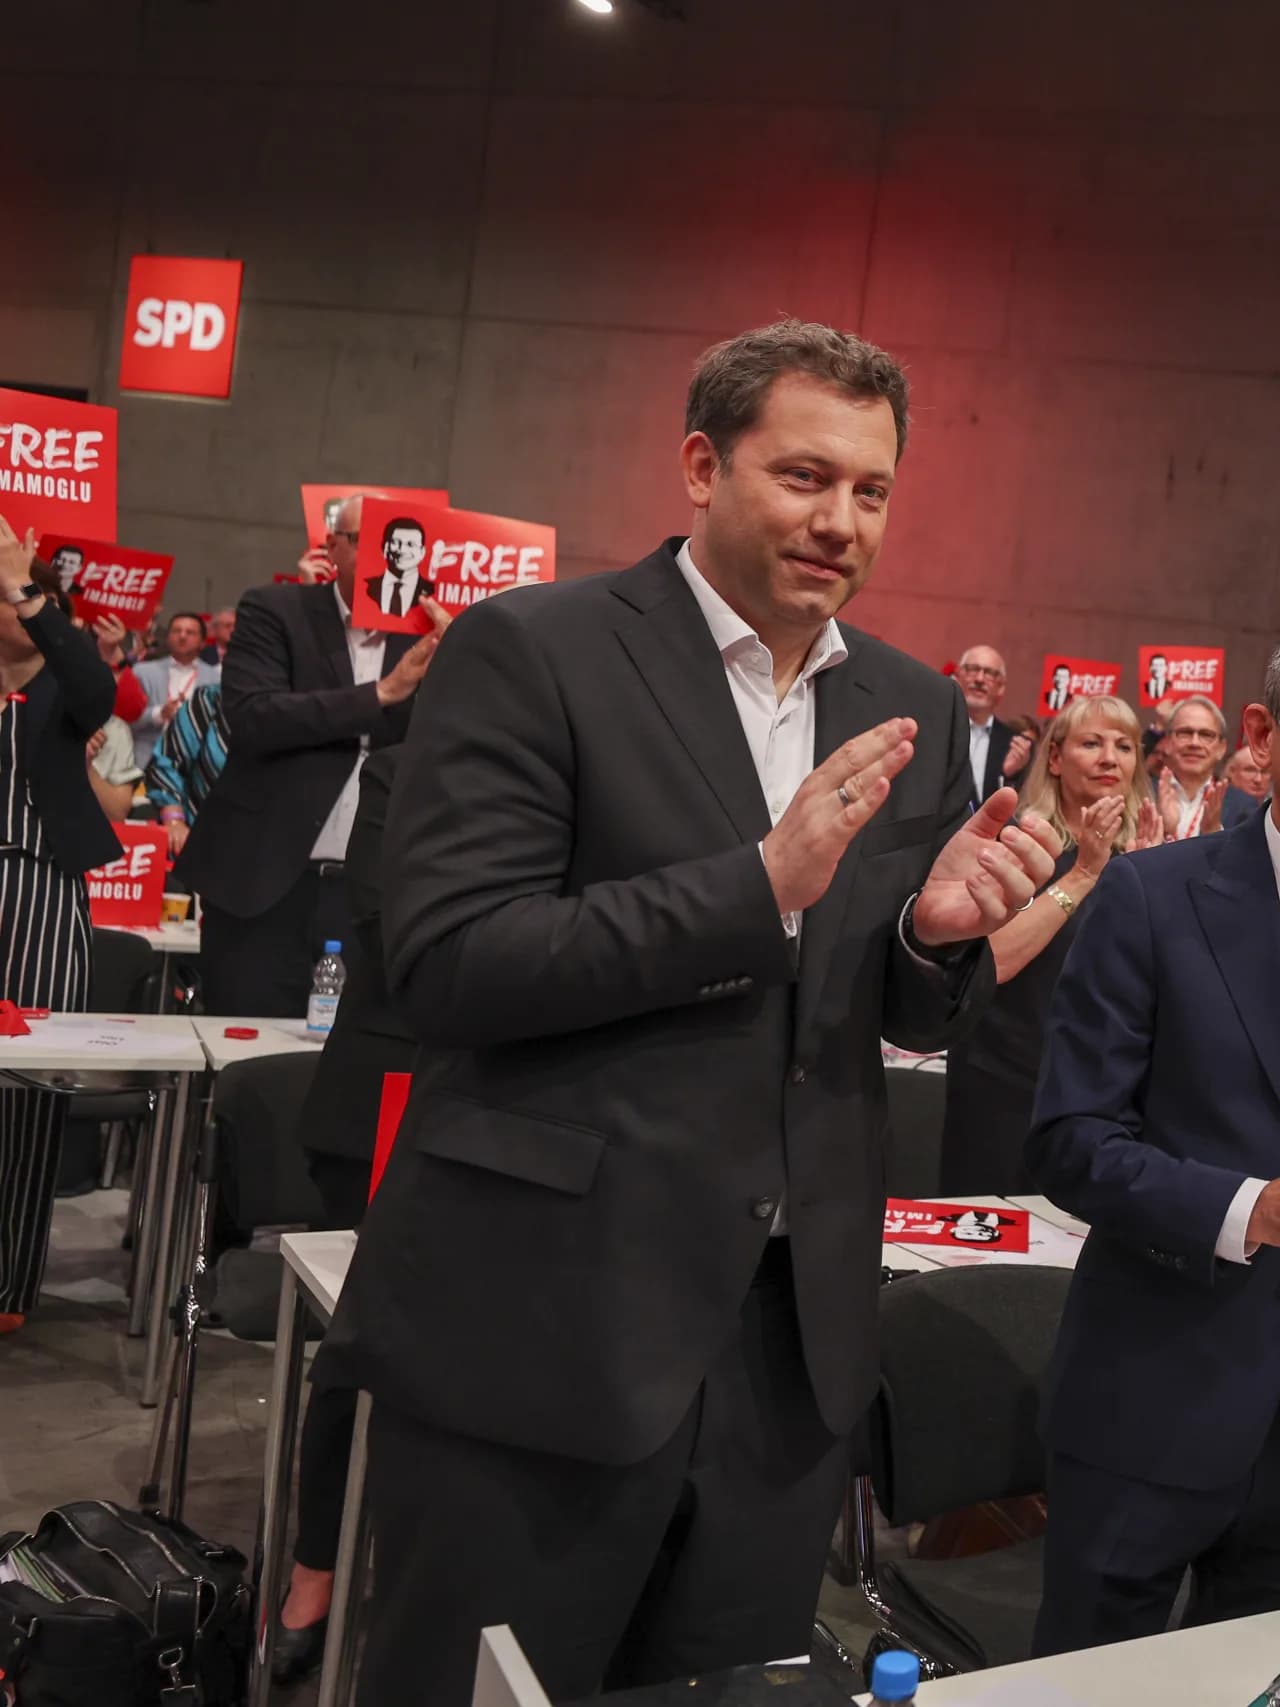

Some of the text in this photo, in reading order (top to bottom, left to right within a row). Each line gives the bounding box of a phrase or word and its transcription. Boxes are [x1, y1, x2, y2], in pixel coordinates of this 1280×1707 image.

[134, 298, 225, 351] SPD
[80, 561, 163, 595] FREE
[428, 539, 544, 583] FREE
[89, 881, 143, 901] MOGLU
